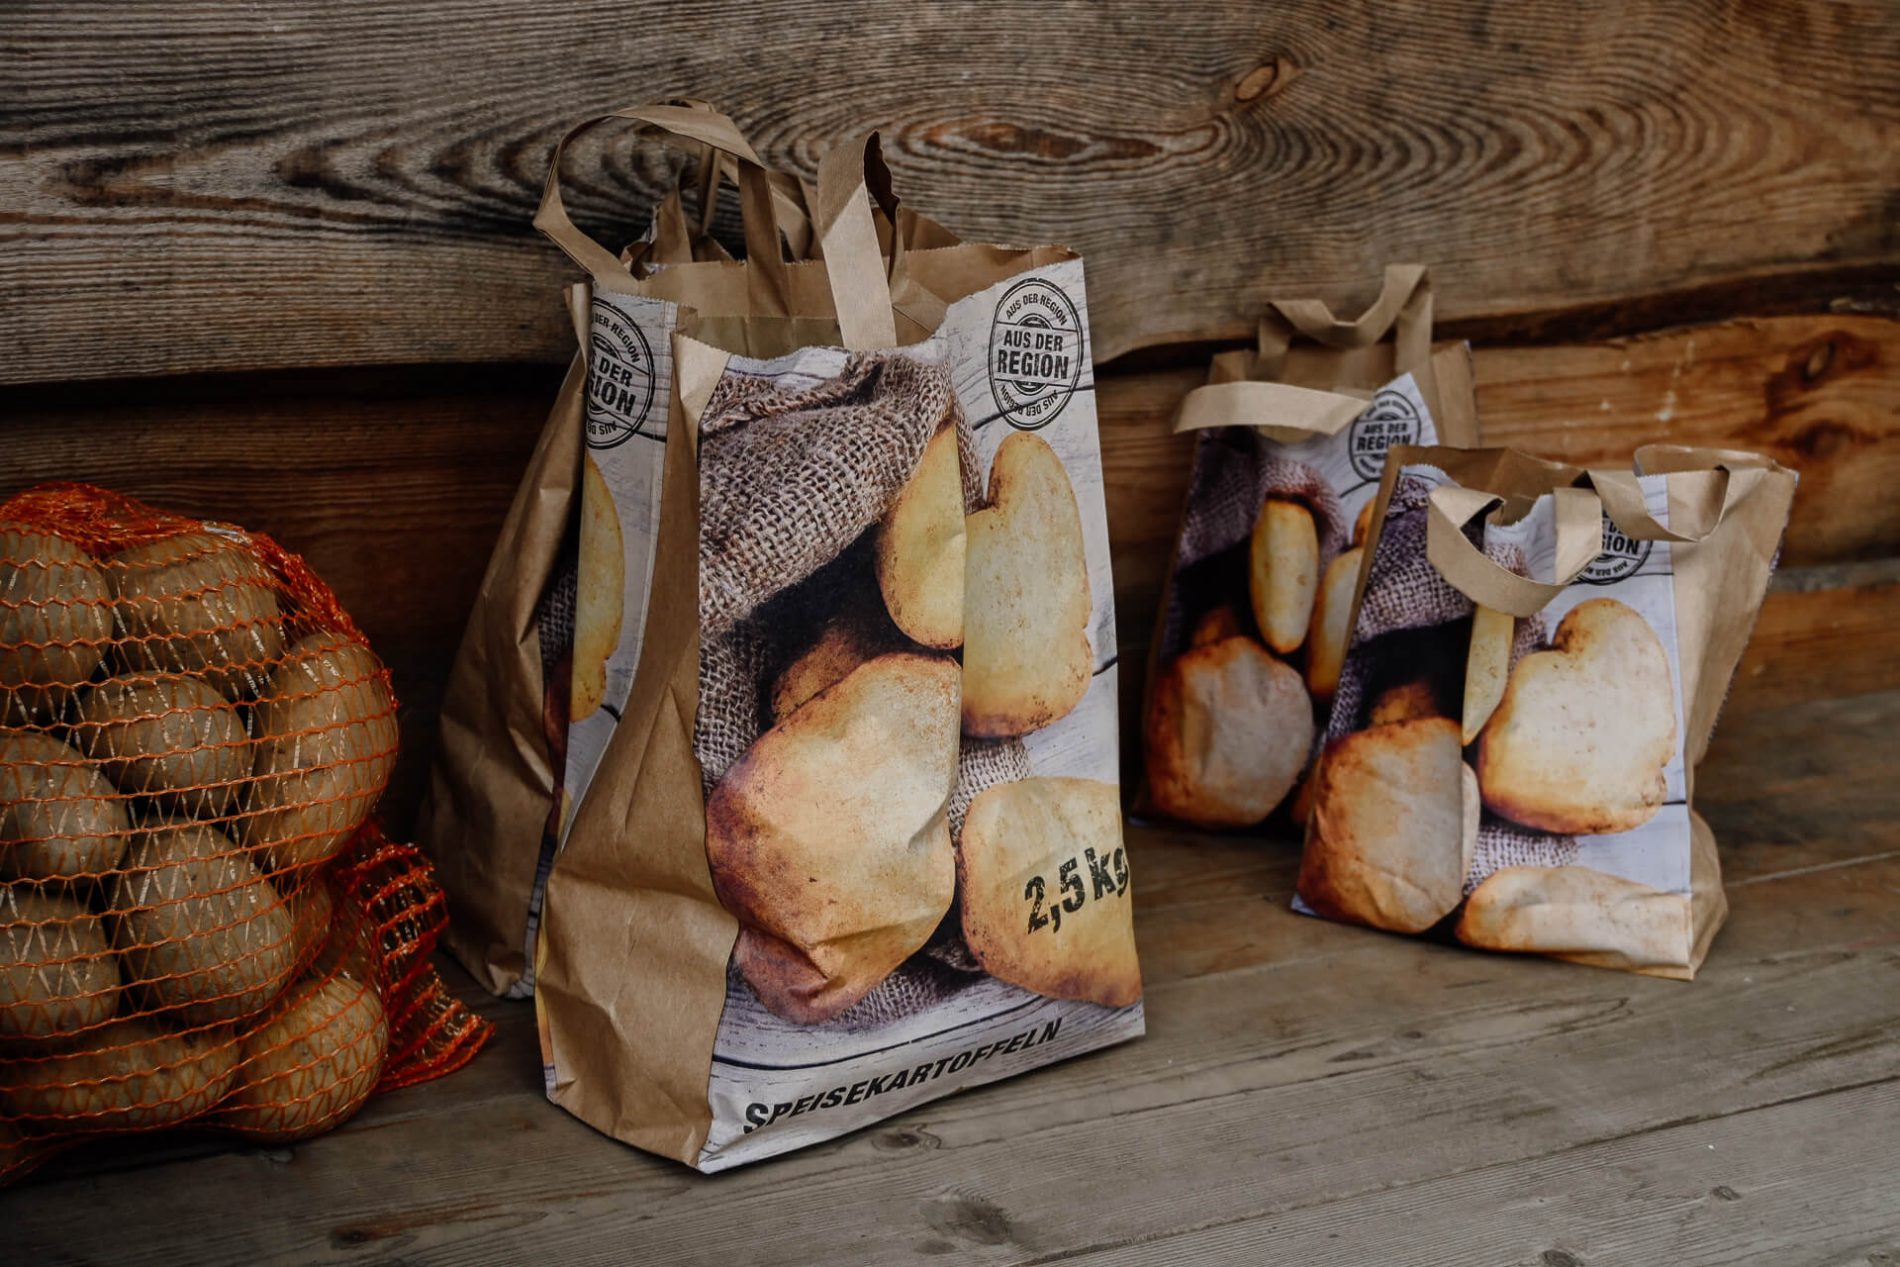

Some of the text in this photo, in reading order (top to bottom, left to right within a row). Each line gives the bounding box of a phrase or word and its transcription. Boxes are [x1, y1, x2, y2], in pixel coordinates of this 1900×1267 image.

[1006, 293, 1068, 326] AUS DER REGION
[610, 322, 640, 363] REGION
[1003, 330, 1064, 352] AUS DER
[599, 356, 633, 388] DER
[997, 349, 1069, 380] REGION
[1363, 422, 1408, 435] AUS DER
[1024, 846, 1129, 935] 2,5 kg
[742, 1016, 1063, 1134] SPEISEKARTOFFELN
